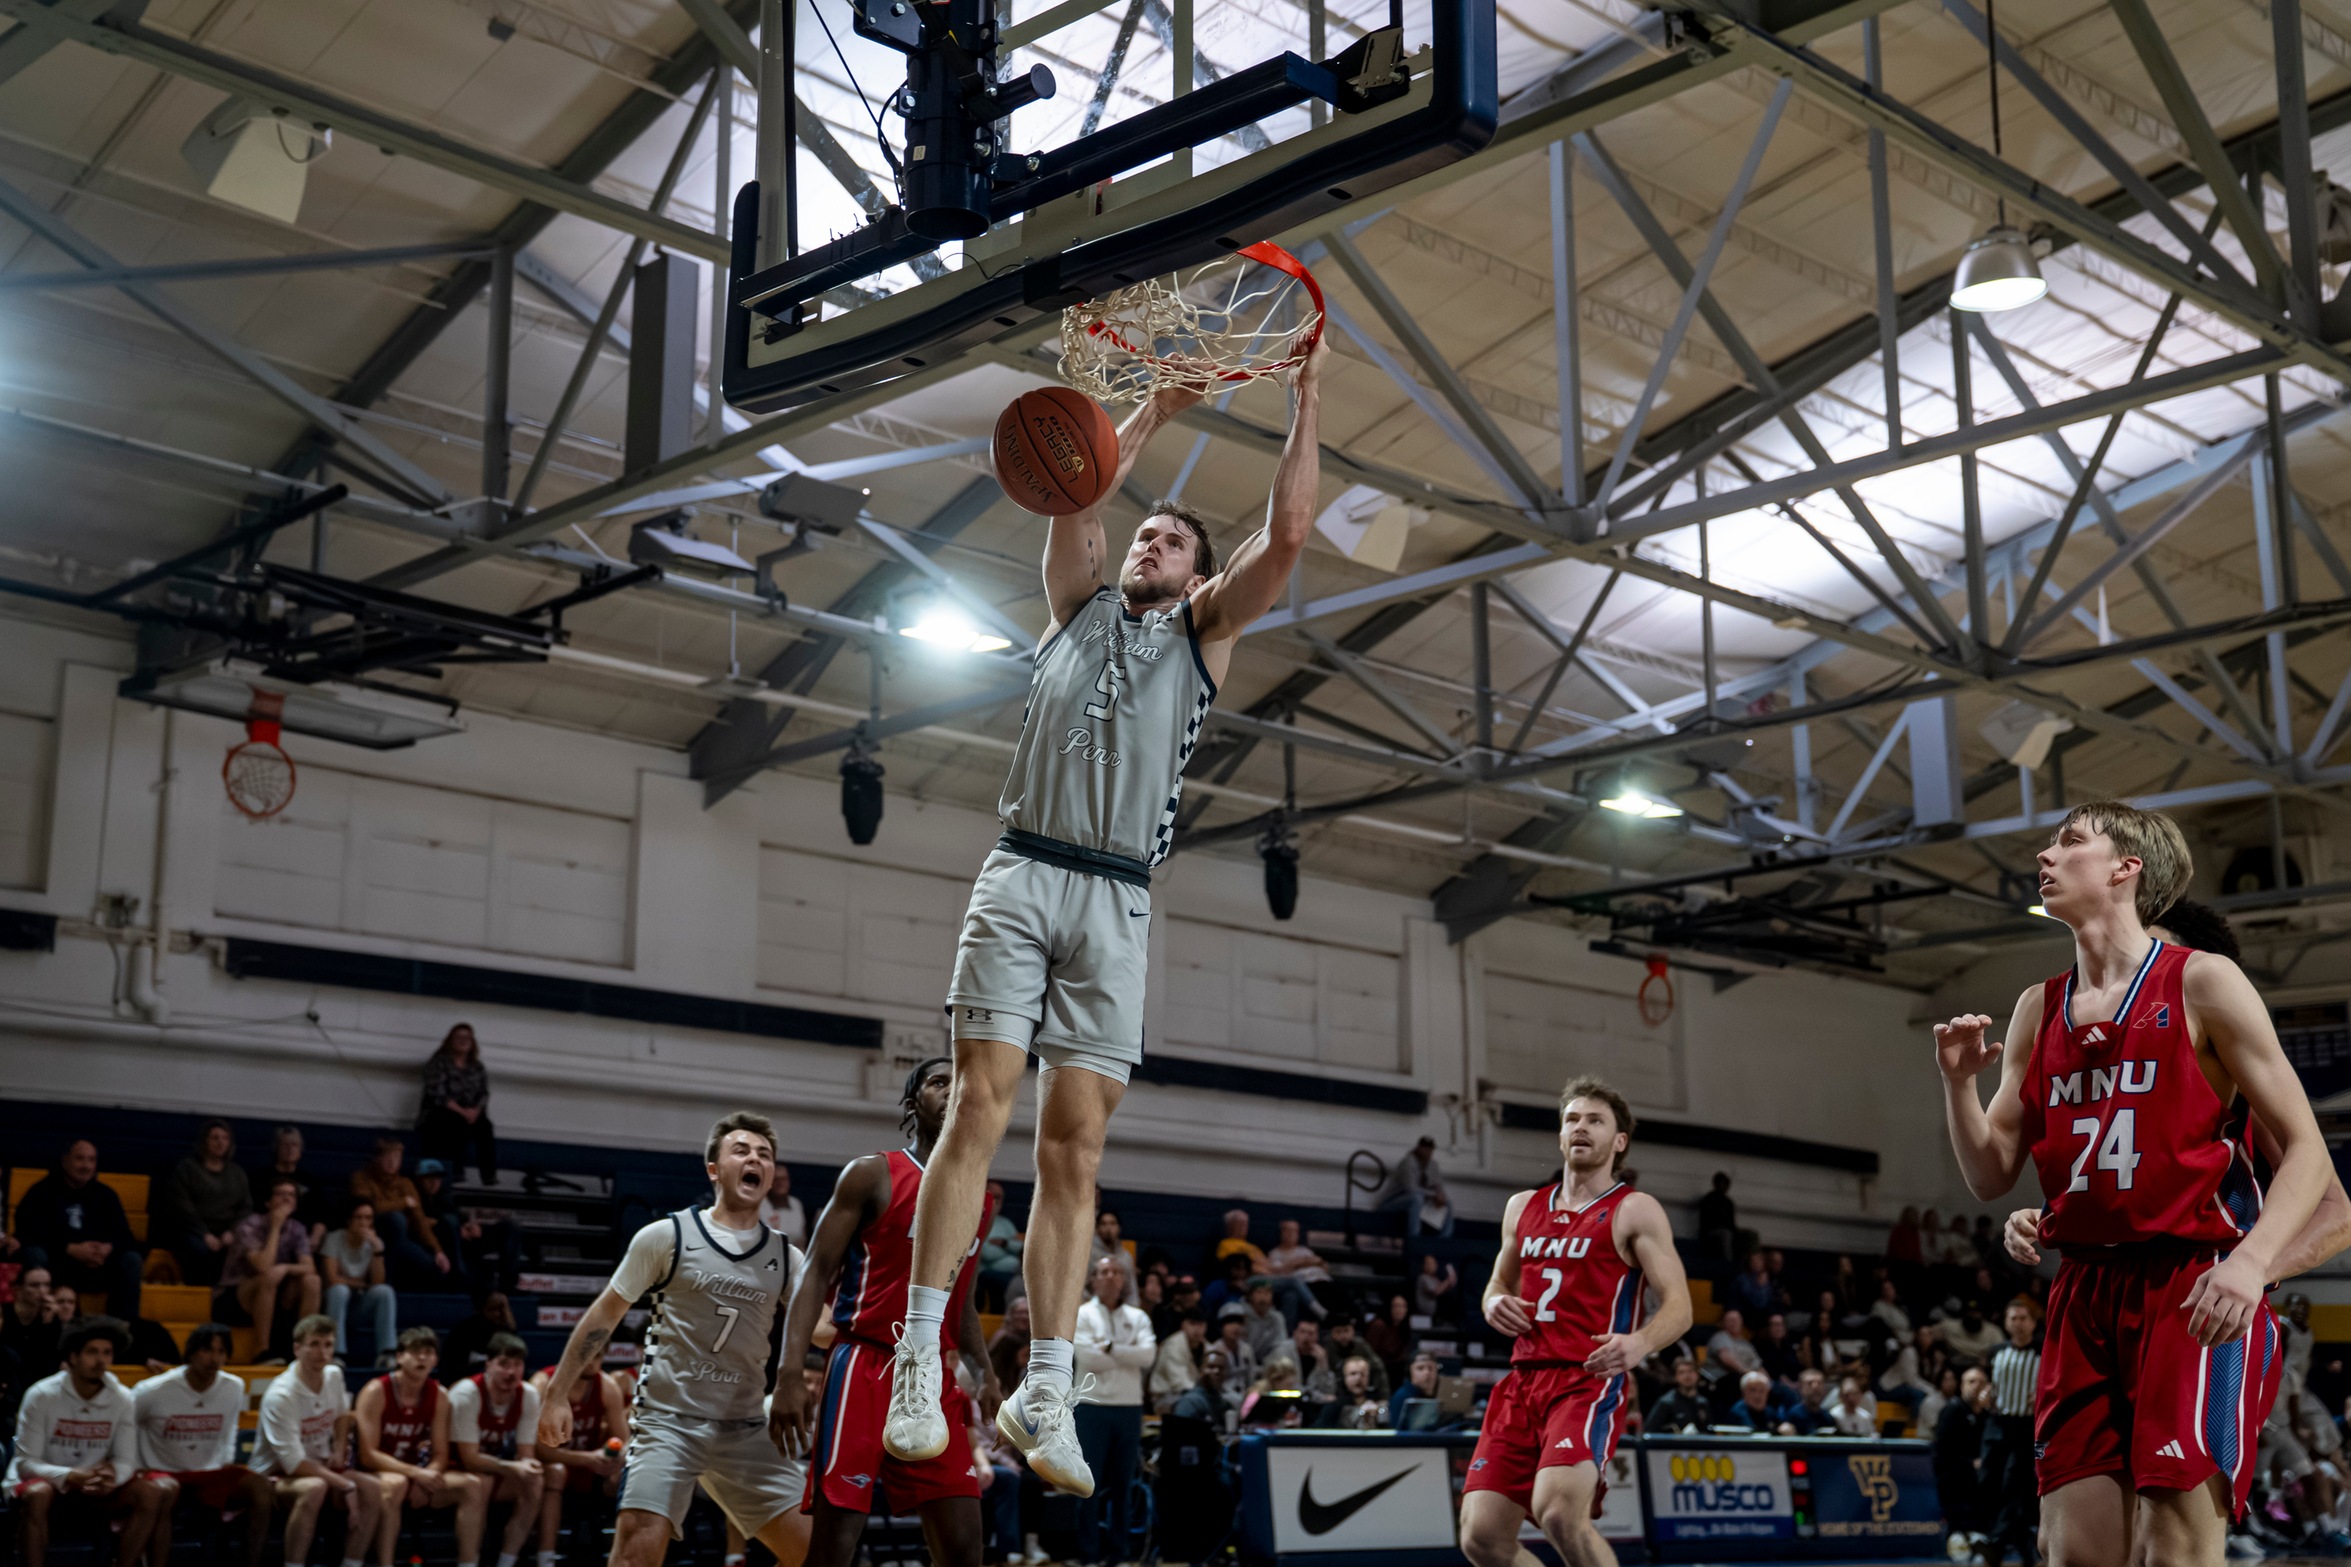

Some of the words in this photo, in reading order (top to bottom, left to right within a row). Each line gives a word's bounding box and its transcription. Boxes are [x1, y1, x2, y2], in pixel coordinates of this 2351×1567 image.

[1033, 417, 1079, 484] LEGACY
[1049, 416, 1077, 455] 1000
[1002, 423, 1058, 503] SPALDING
[1081, 619, 1164, 661] William
[1083, 658, 1127, 722] 5
[1058, 726, 1122, 768] Penn
[2048, 1060, 2158, 1107] MNU
[2065, 1108, 2142, 1194] 24
[1520, 1236, 1592, 1259] MNU
[691, 1269, 768, 1304] William
[1534, 1267, 1563, 1322] 2
[712, 1305, 740, 1353] 7
[690, 1360, 742, 1384] Penn
